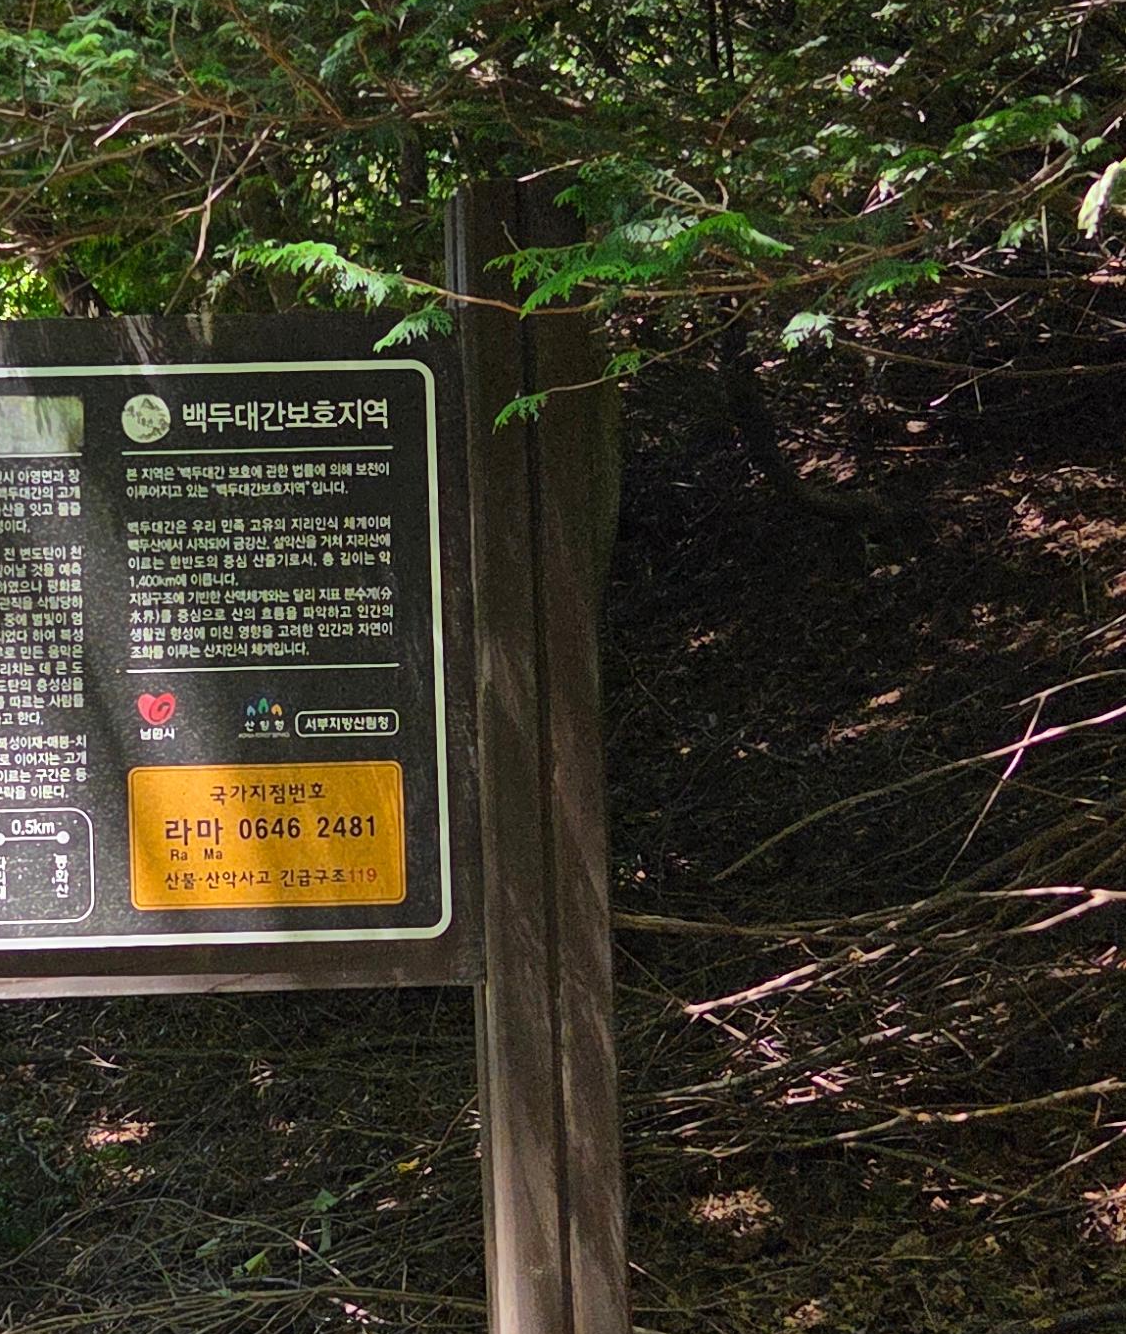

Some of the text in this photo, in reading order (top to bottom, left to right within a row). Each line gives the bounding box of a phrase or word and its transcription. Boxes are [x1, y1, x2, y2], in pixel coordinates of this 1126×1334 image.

[182, 398, 388, 433] 백두대간보호지역
[141, 466, 174, 481] 지역은
[192, 519, 215, 533] 우리
[305, 715, 389, 731] 서부지방산림청
[210, 782, 326, 805] 국가지점번호
[11, 819, 55, 835] 0.5km
[165, 816, 376, 846] 라마 0646 2481
[170, 849, 223, 861] Ra Ma
